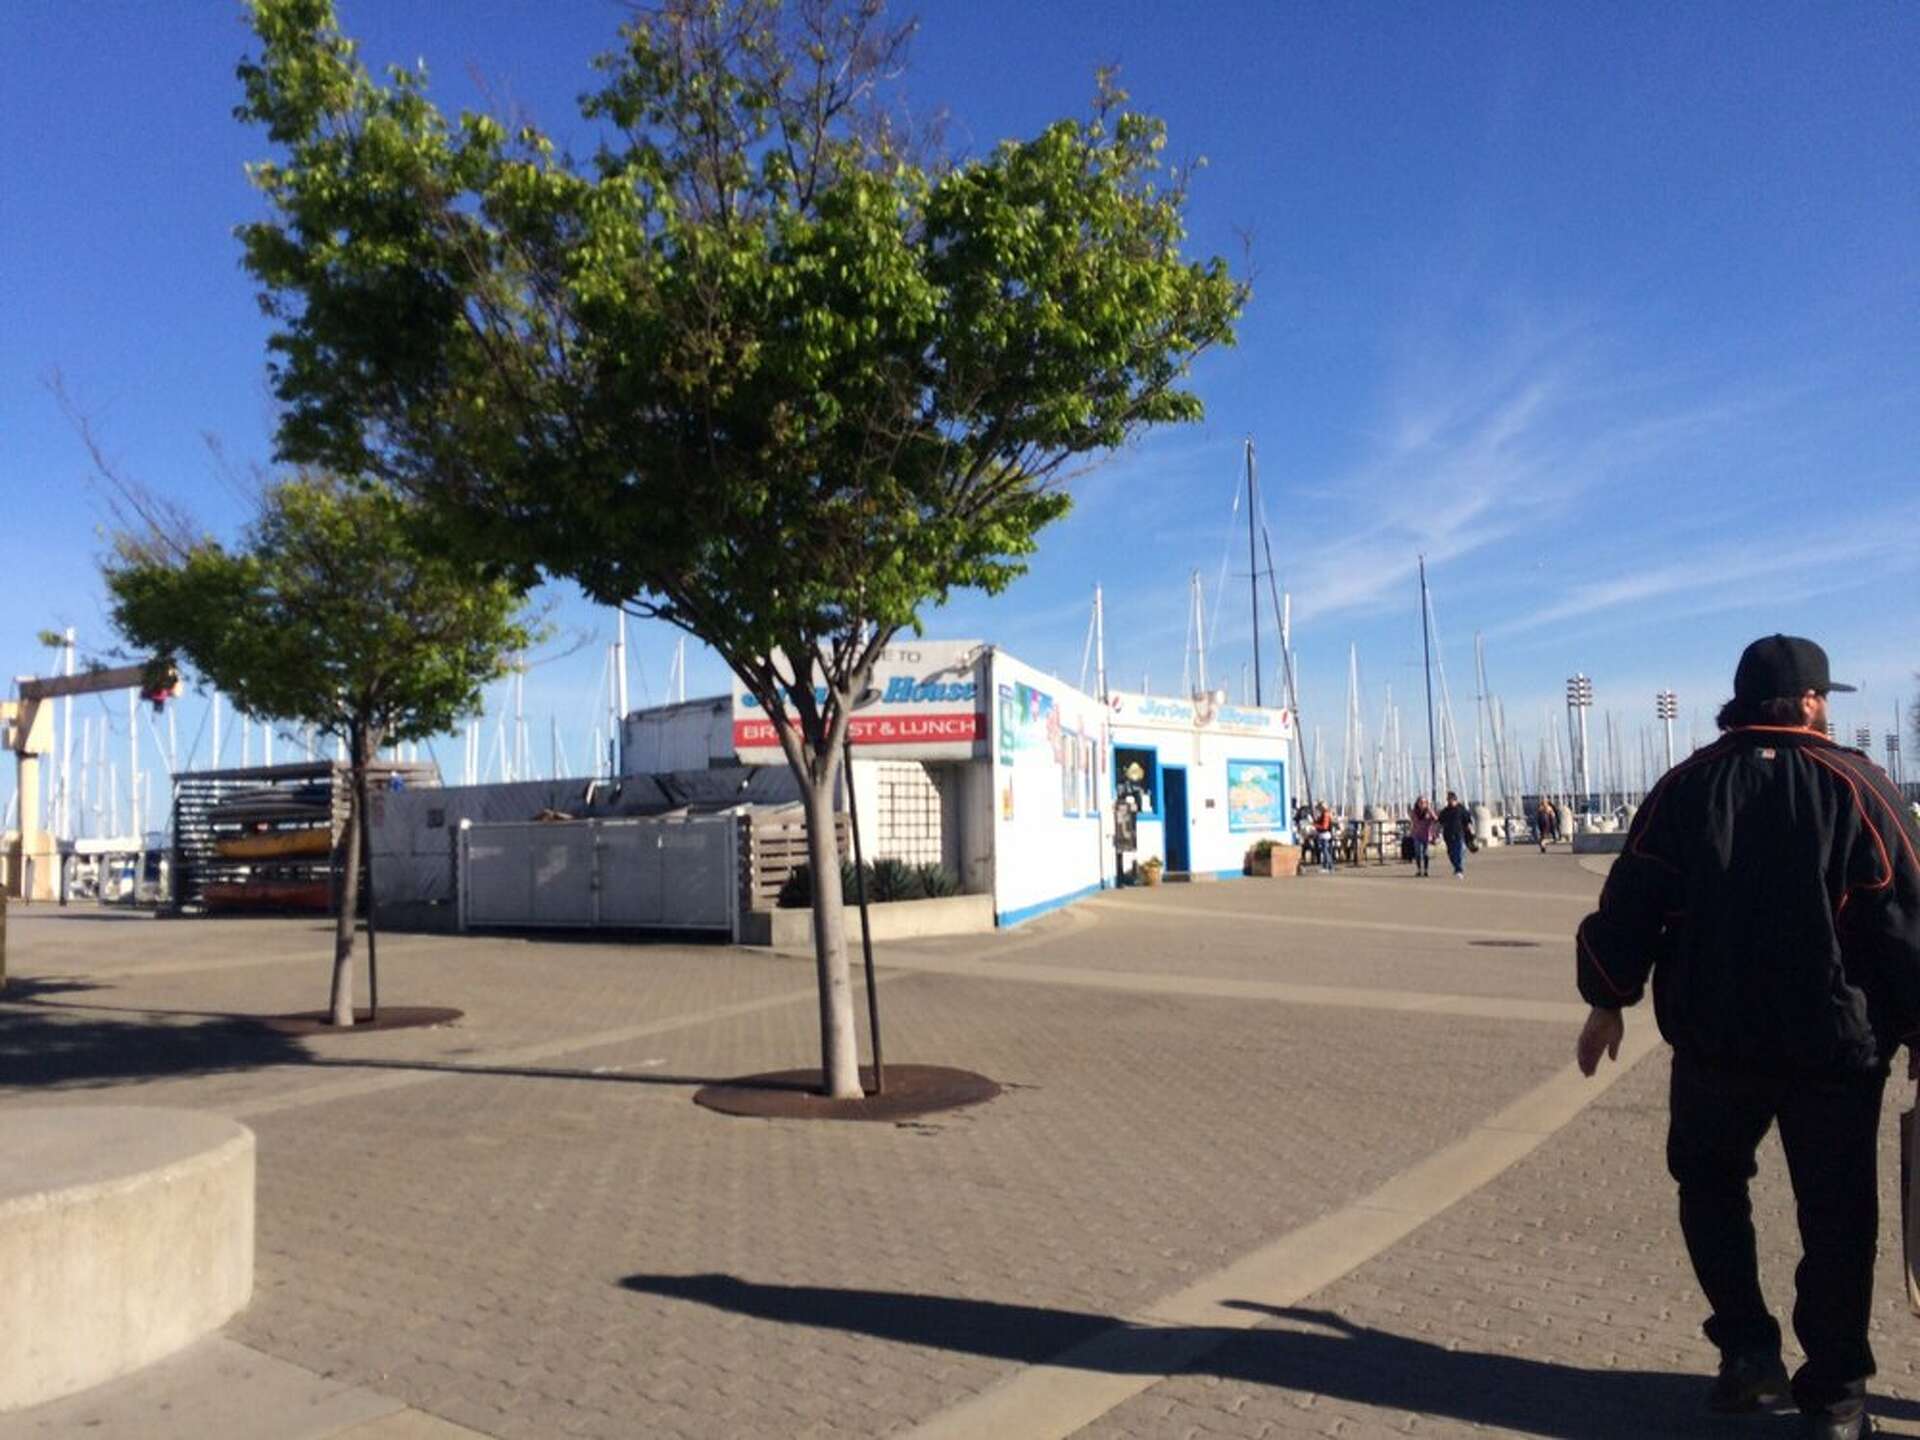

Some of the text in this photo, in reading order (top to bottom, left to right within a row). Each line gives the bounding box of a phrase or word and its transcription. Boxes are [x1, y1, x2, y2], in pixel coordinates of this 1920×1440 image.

[899, 649, 921, 663] TO
[881, 676, 977, 704] House
[880, 721, 896, 736] &
[899, 719, 977, 735] LUNCH
